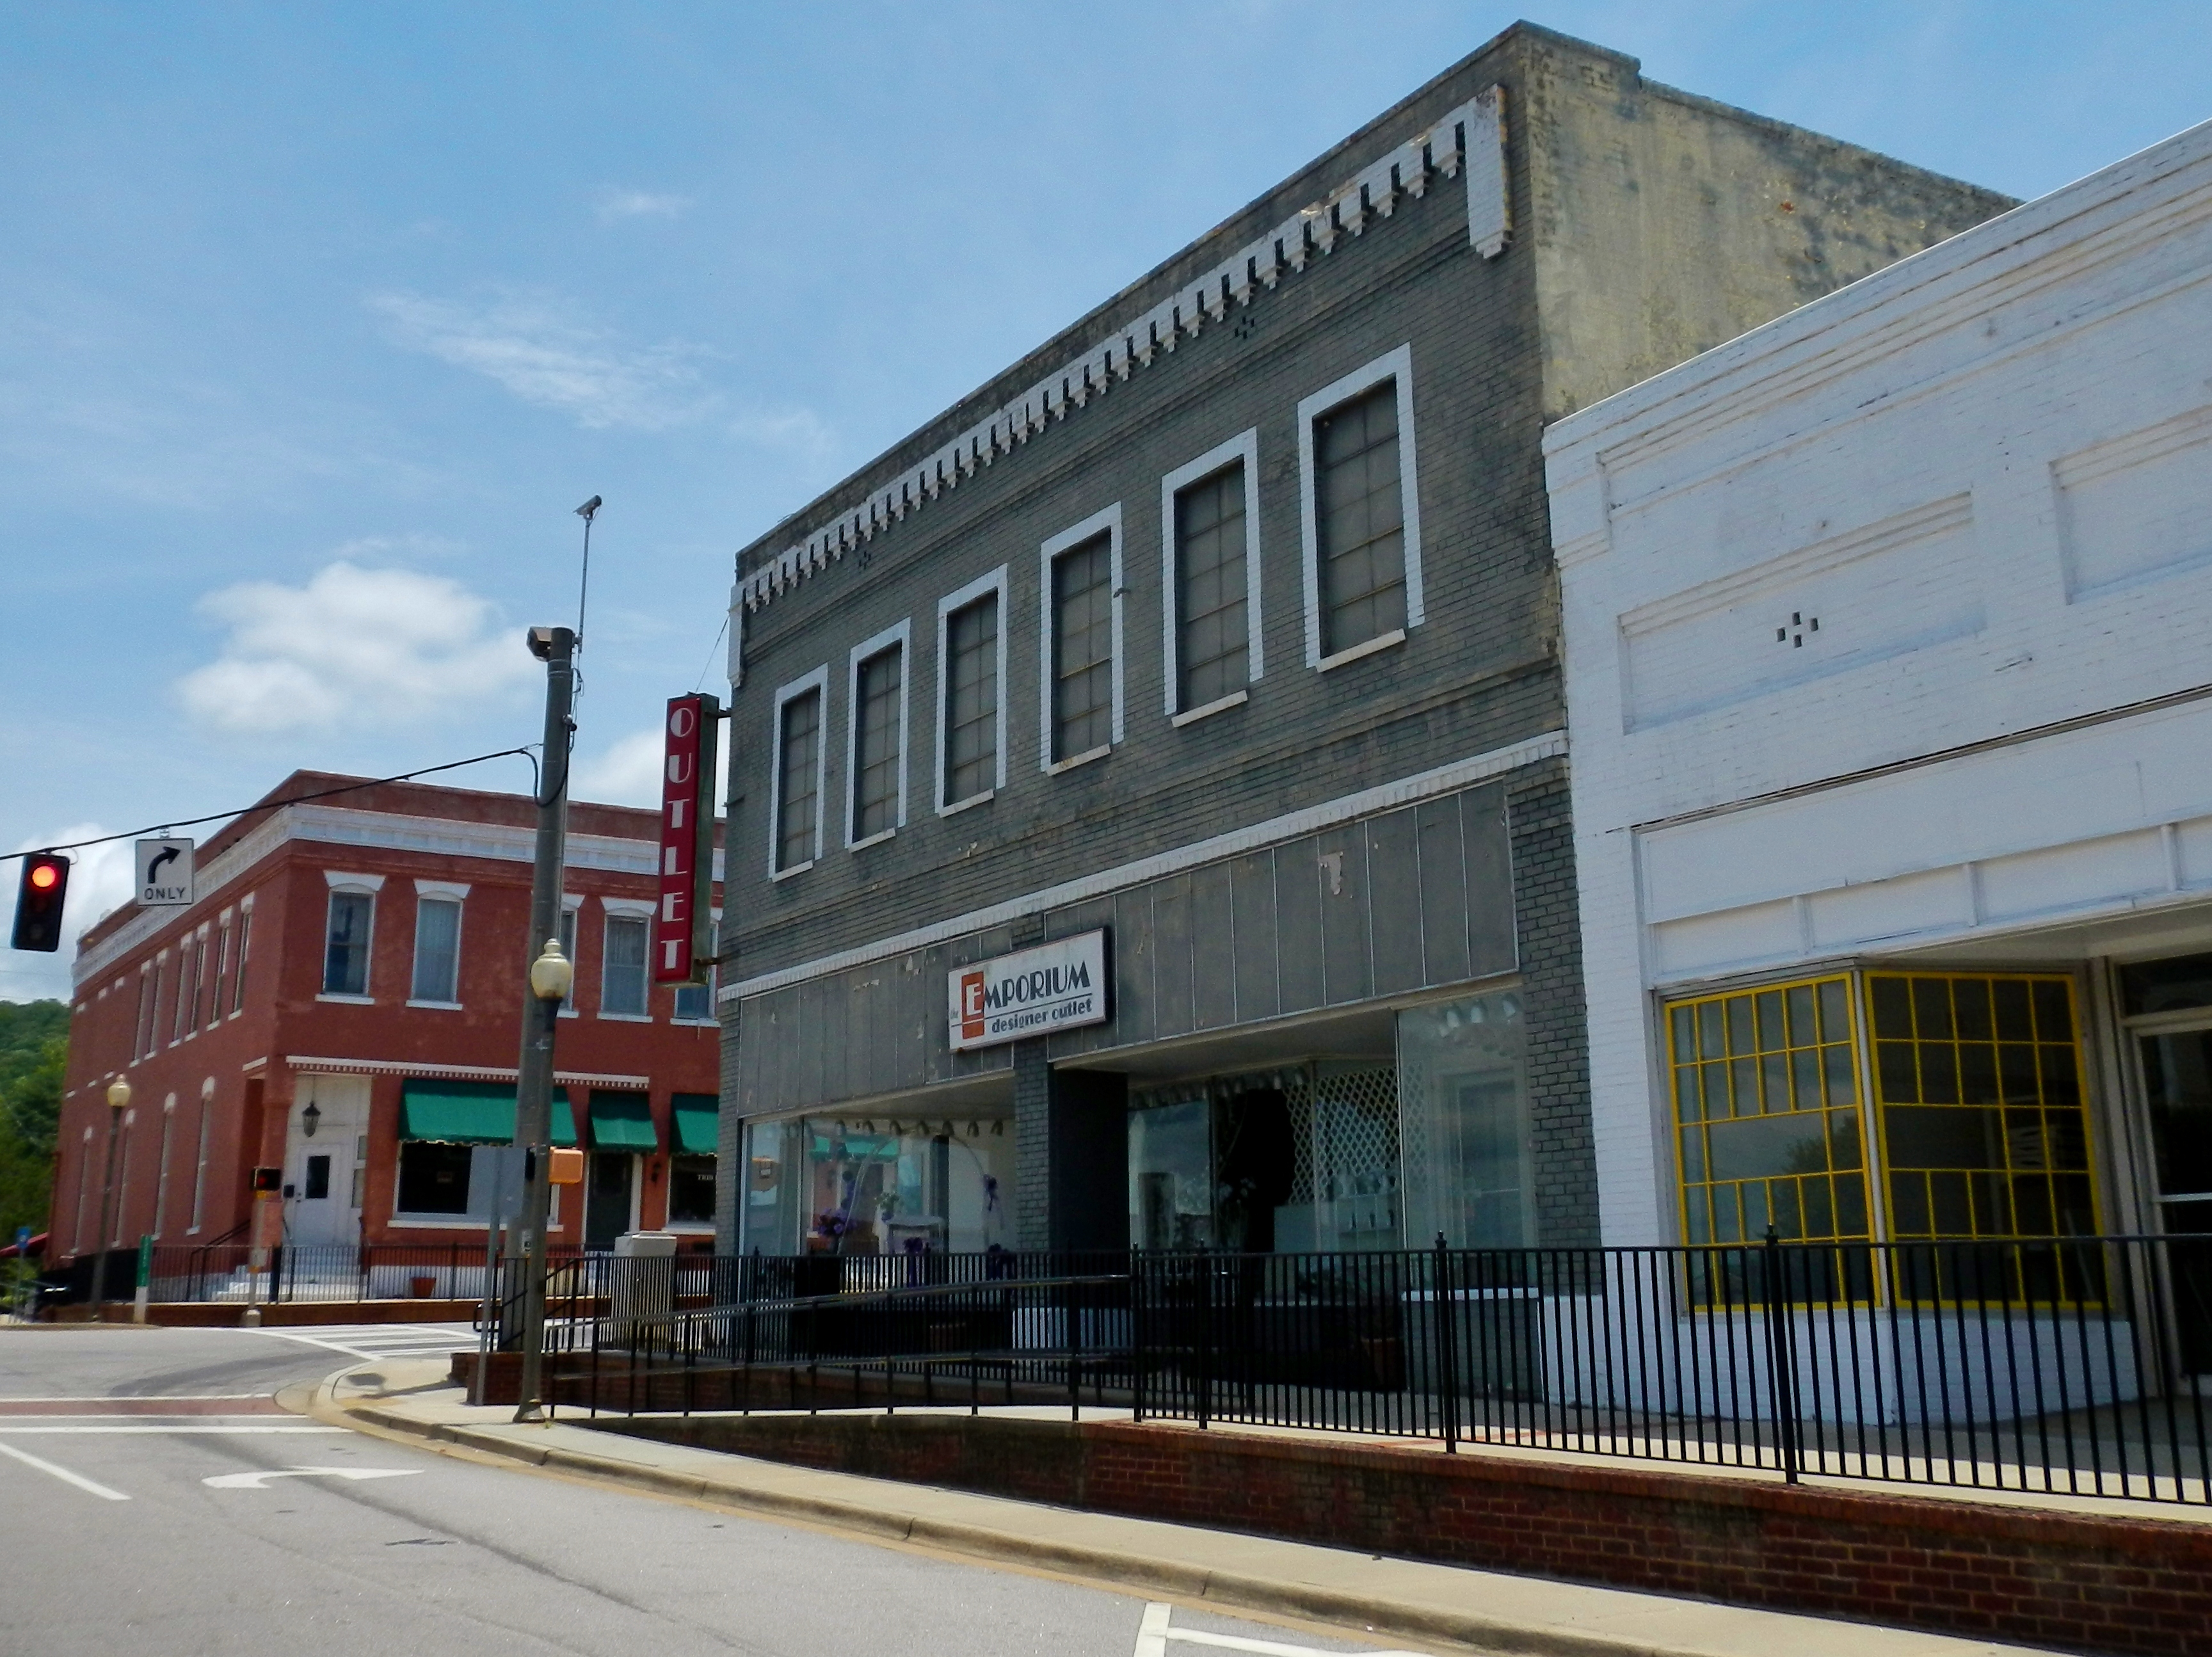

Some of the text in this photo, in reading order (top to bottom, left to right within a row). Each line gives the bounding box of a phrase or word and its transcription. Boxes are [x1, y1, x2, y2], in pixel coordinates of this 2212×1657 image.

[661, 707, 694, 970] OUTLET
[144, 886, 186, 900] ONLY
[965, 960, 1091, 1016] EMPORIUM
[991, 998, 1093, 1034] designer outlet
